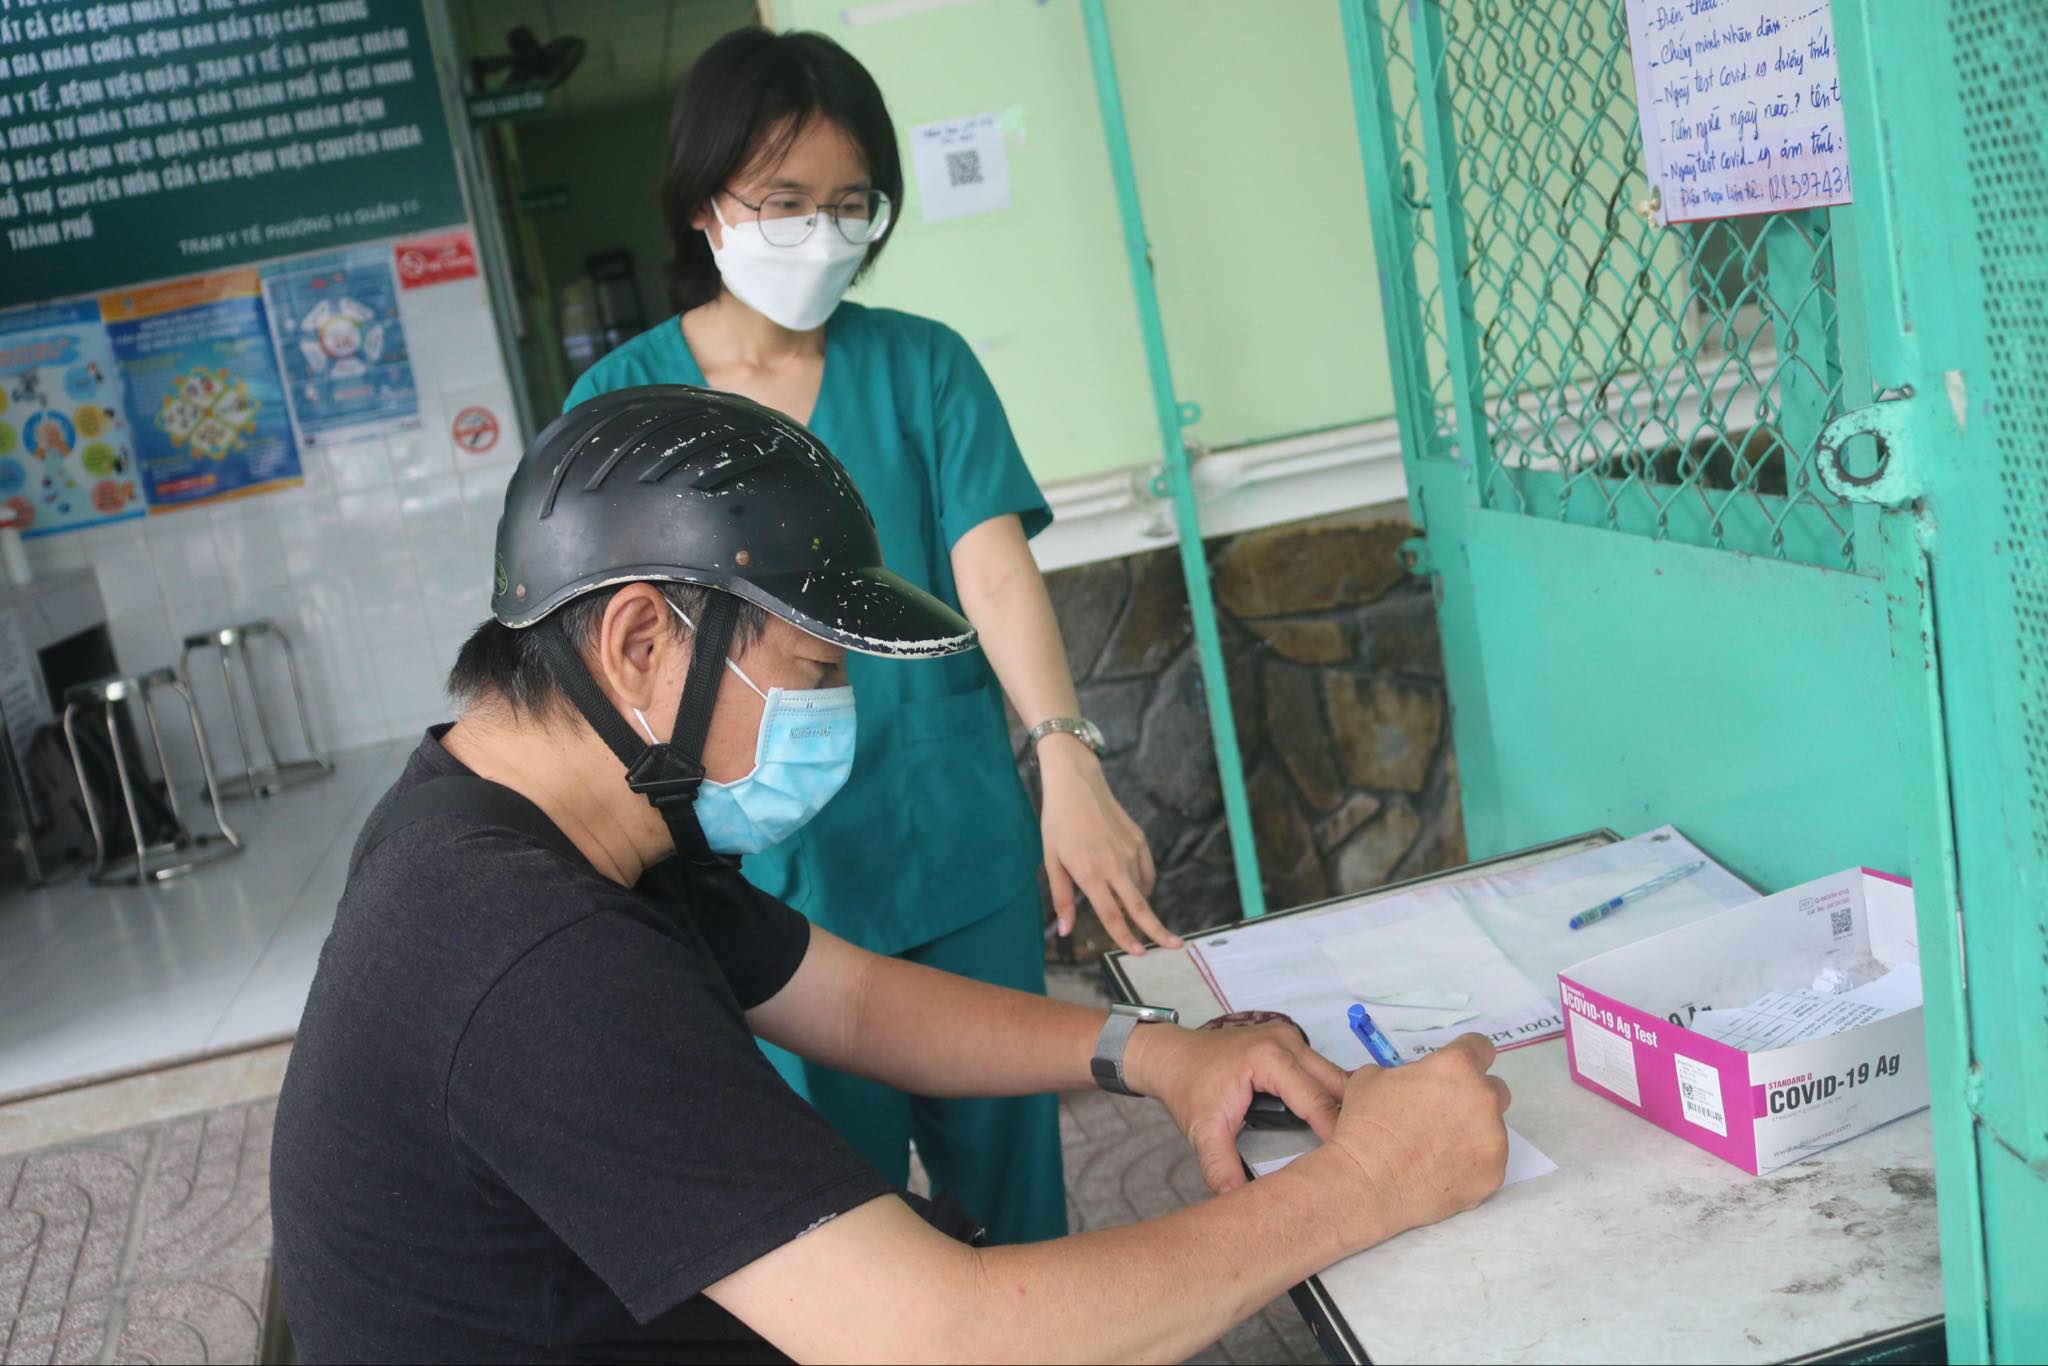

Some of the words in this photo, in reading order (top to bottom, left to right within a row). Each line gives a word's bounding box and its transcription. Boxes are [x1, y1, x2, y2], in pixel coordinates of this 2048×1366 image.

[51, 8, 85, 36] CÁC
[1567, 992, 1615, 1029] COVID-19
[1616, 1015, 1632, 1040] Ag
[1633, 1022, 1659, 1049] Test
[1768, 1075, 1806, 1090] STANDARD
[1769, 1062, 1870, 1114] COVID-19
[1875, 1053, 1901, 1079] Ag
